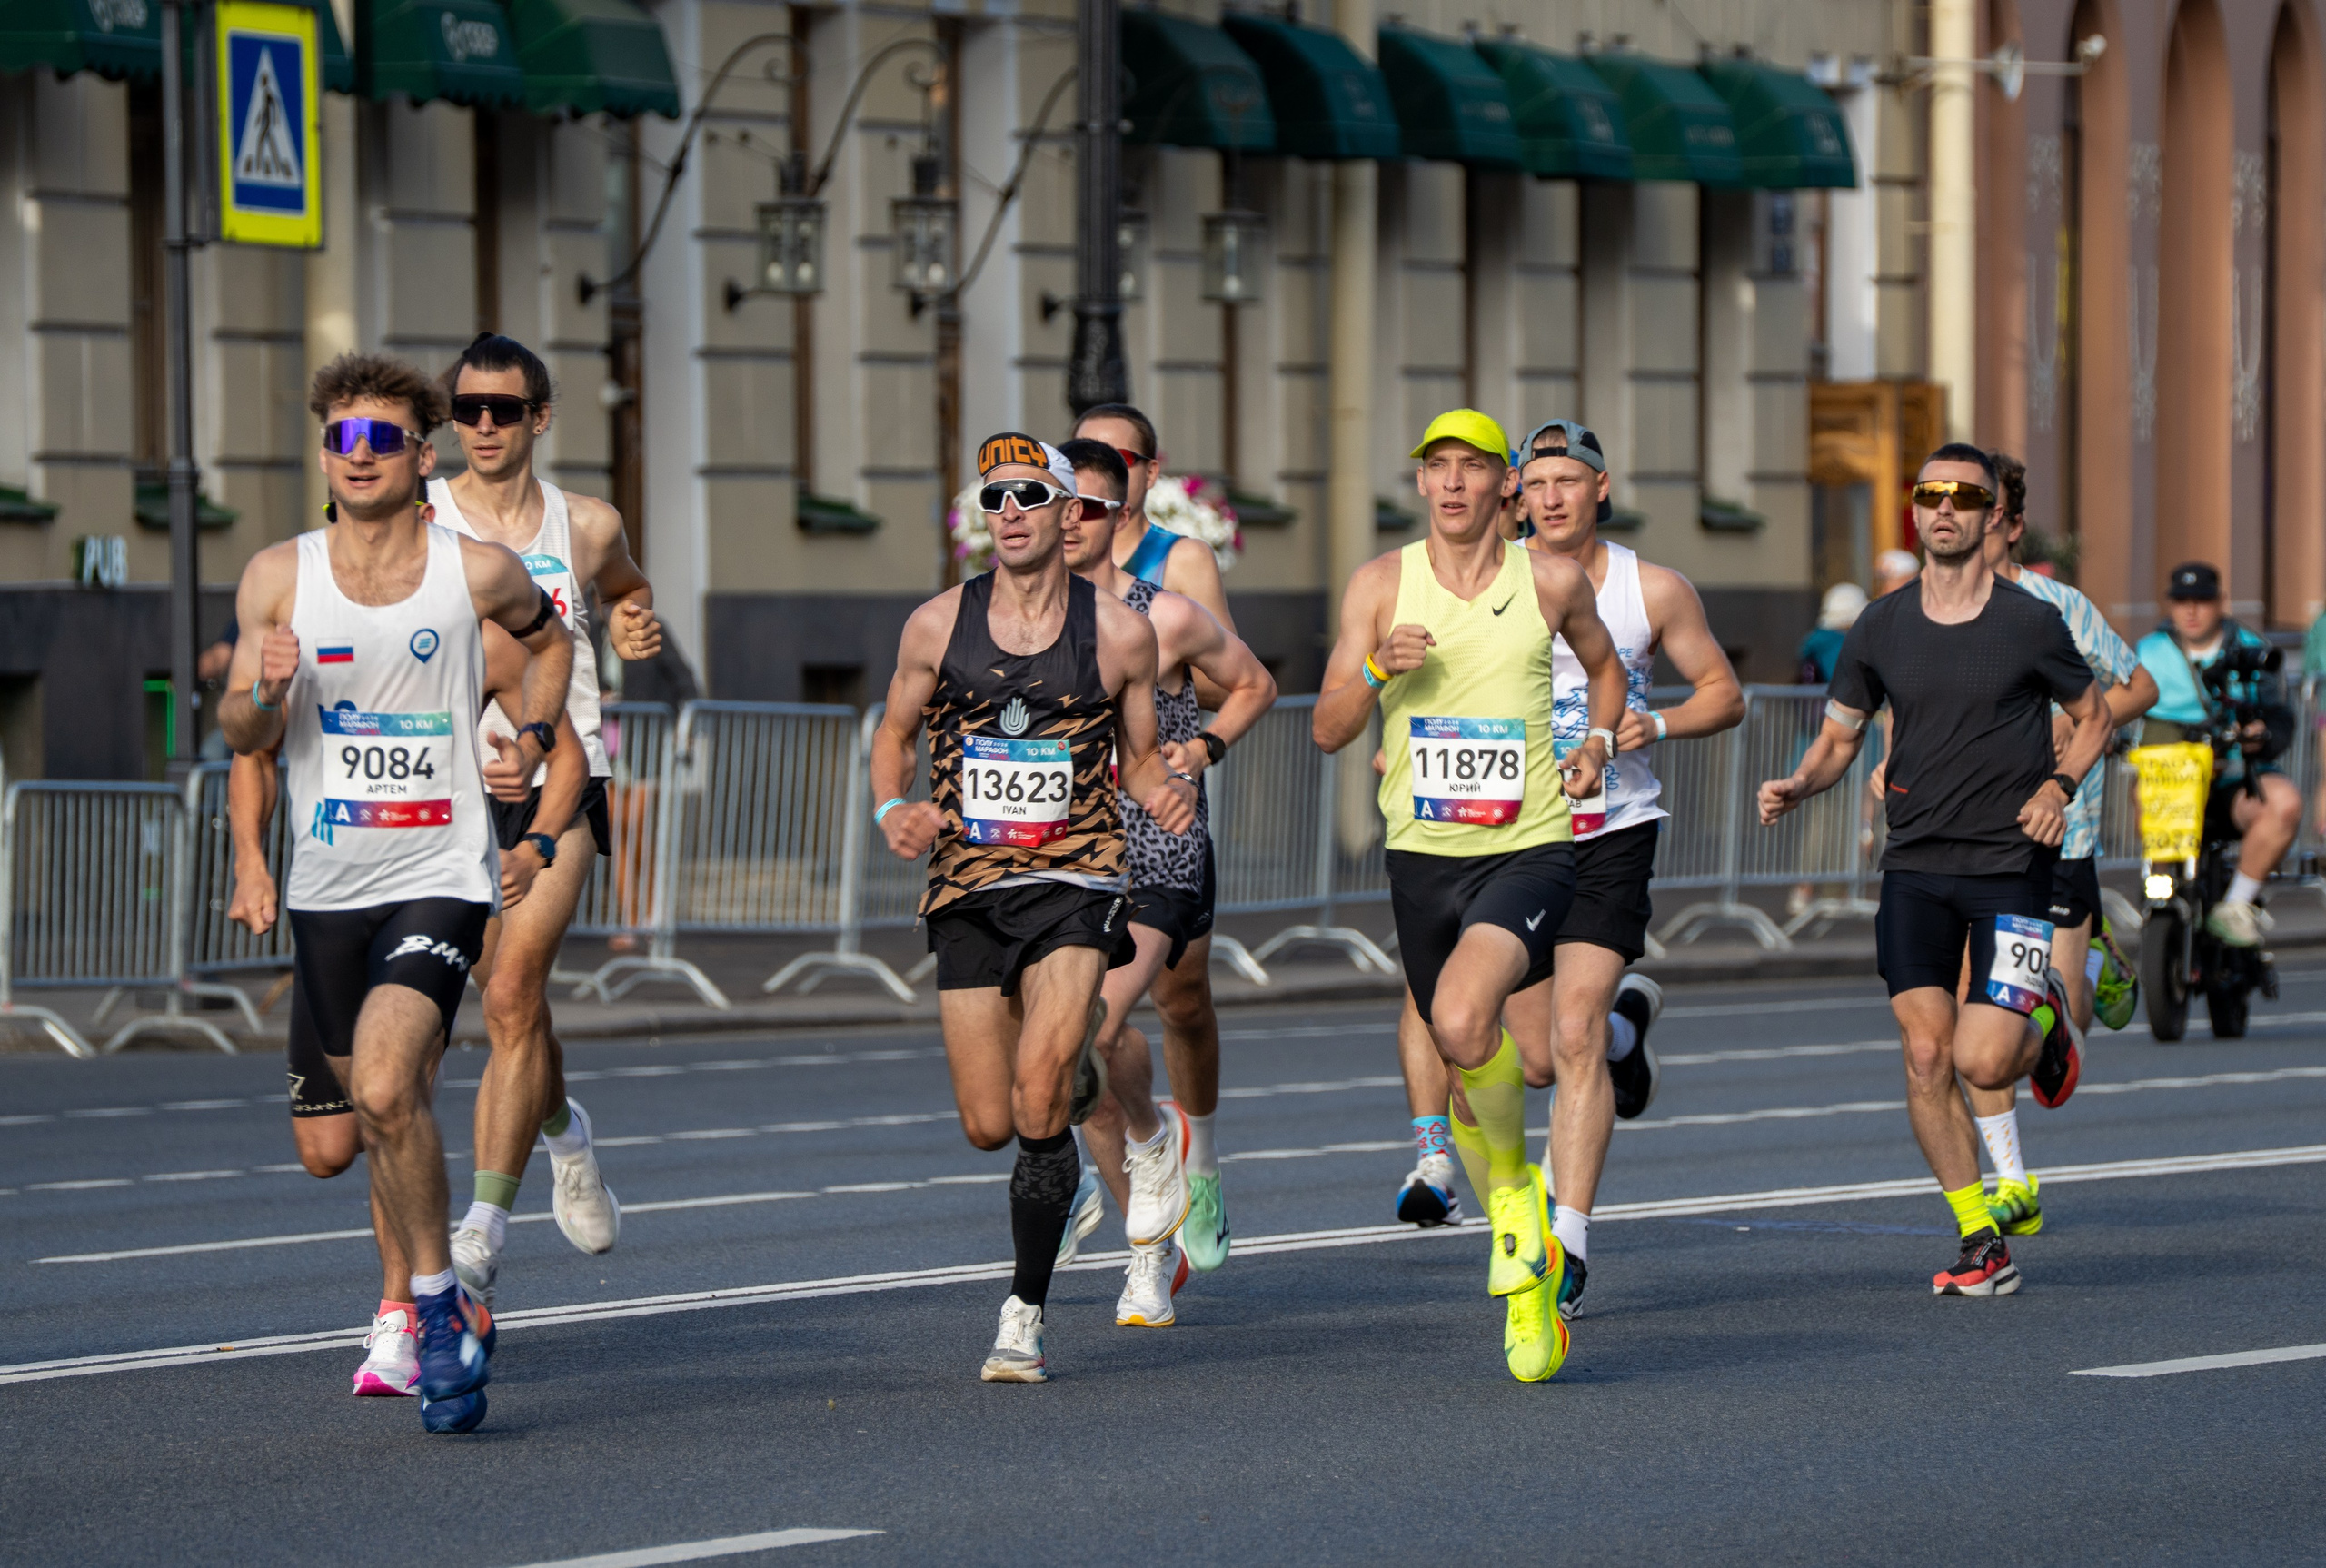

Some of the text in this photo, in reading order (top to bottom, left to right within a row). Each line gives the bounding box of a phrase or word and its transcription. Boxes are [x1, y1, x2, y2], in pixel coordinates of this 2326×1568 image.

[524, 561, 533, 571] 0
[399, 719, 433, 729] 10 KM
[1478, 724, 1508, 734] 10 KM
[975, 746, 1009, 755] МАРАФОН
[1026, 747, 1056, 756] 10 KM
[341, 745, 435, 780] 9084
[1416, 747, 1519, 780] 11878
[366, 784, 407, 795] АРТЕМ
[967, 767, 1068, 803] 13623
[1449, 781, 1481, 793] ЮРИЙ
[335, 802, 352, 822] A
[1002, 805, 1027, 815] IVAN
[1420, 799, 1435, 819] A
[969, 821, 982, 840] A
[1995, 984, 2011, 1003] A
